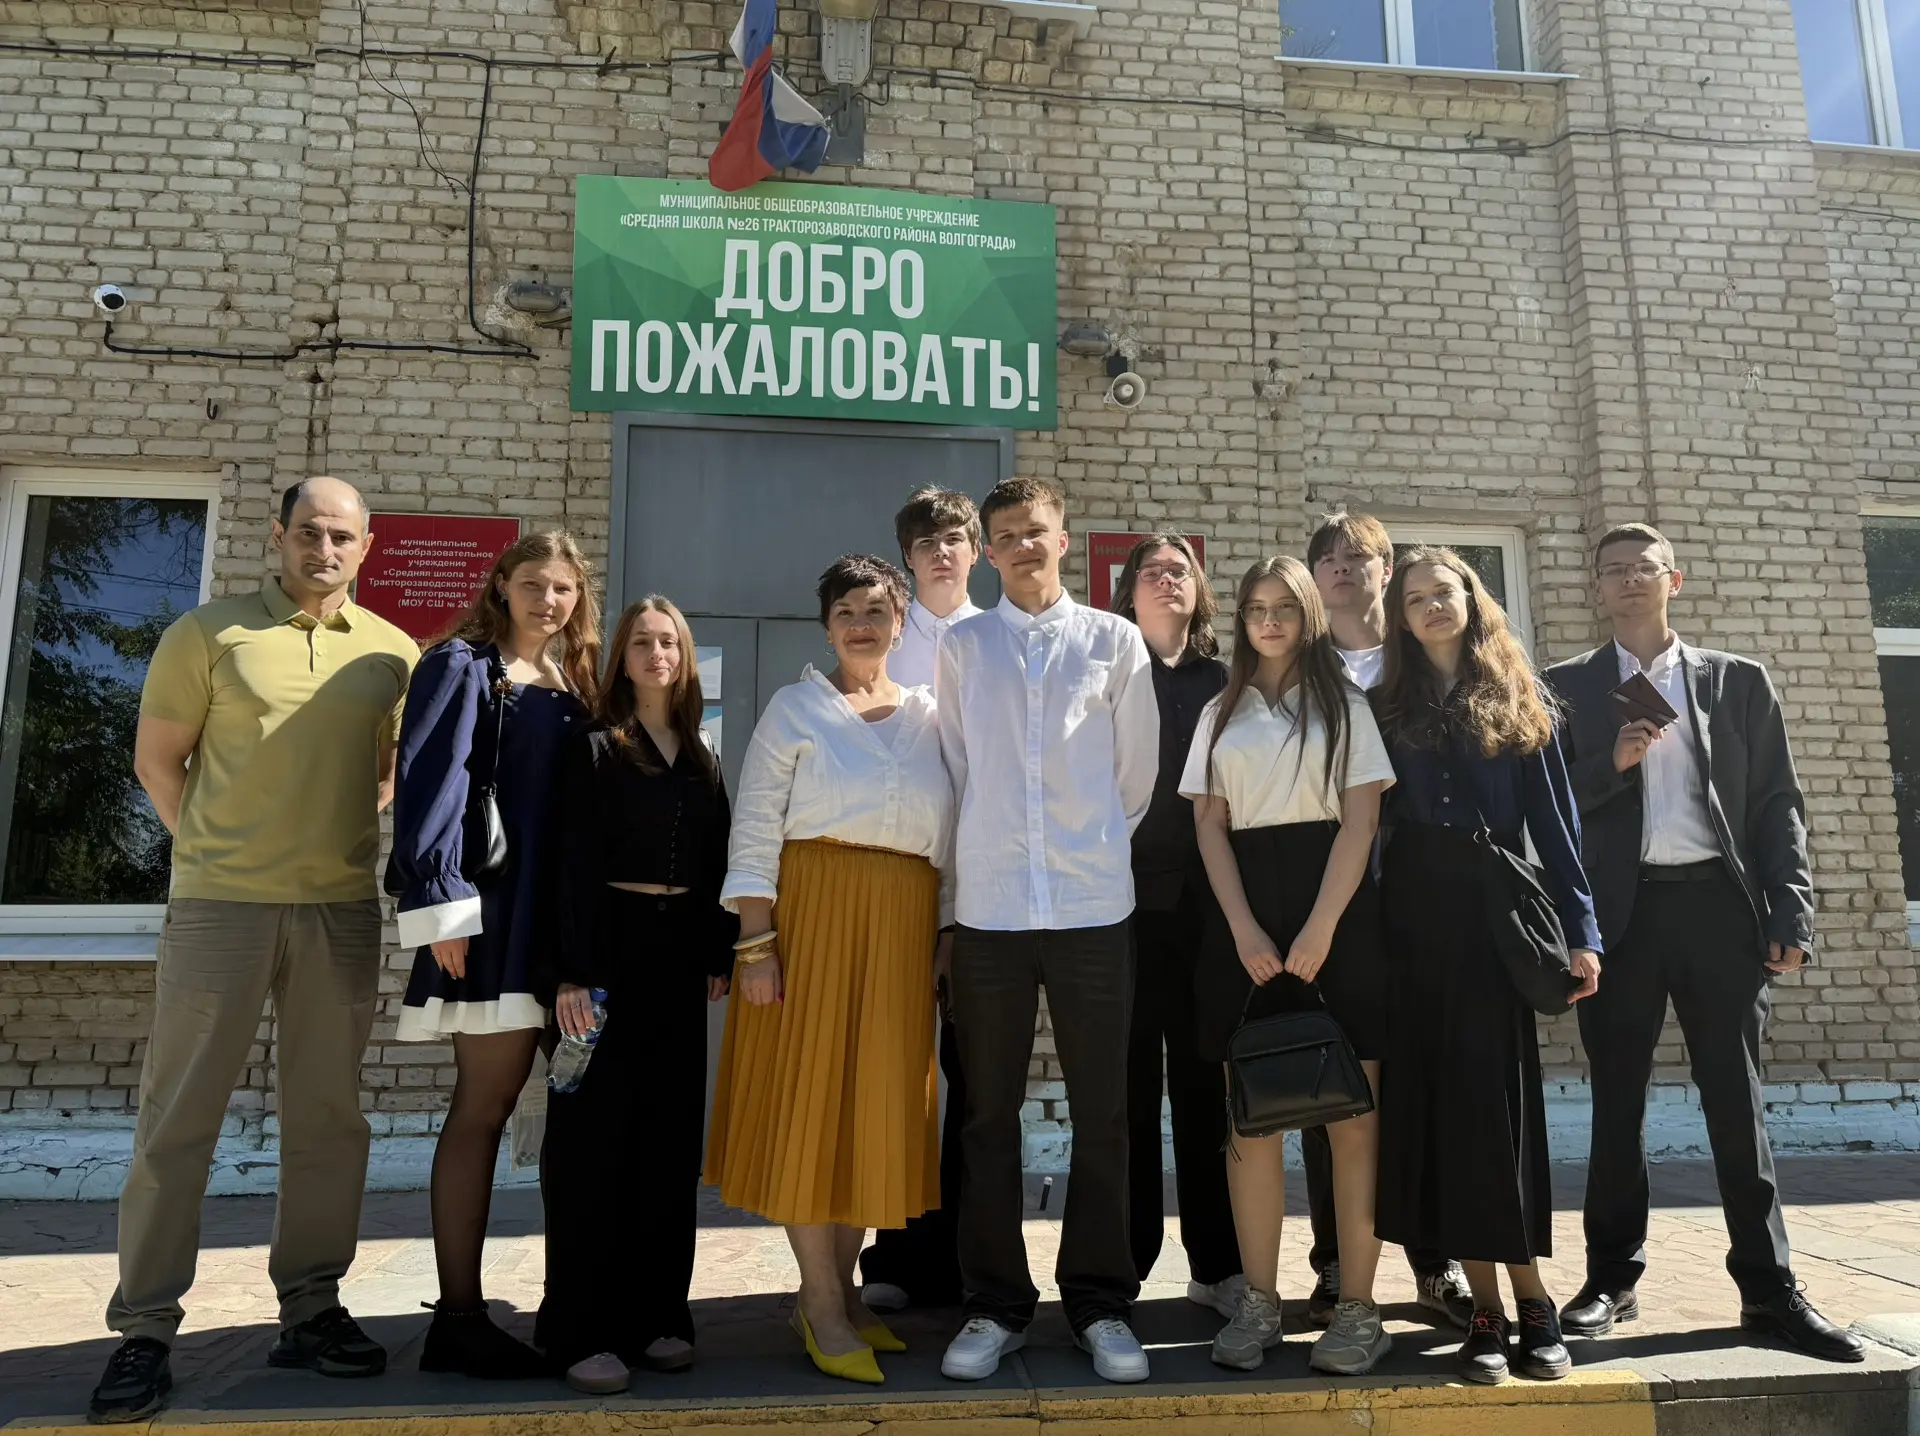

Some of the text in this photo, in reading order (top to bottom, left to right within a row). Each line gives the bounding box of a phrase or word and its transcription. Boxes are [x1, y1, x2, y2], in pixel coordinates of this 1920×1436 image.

[660, 194, 980, 228] МУНИЦИПАЛЬНОЕ ОБЩЕОБРАЗОВАТЕЛЬНОЕ УЧРЕЖДЕНИЕ
[620, 213, 1016, 251] «СРЕДНЯЯ ШКОЛА №26 ТРАКТОРОЗАВОДСКОГО РАЙОНА ВОЛГОГРАДА»
[715, 238, 925, 319] ДОБРО
[590, 319, 1040, 412] ПОЖАЛОВАТЬ!
[400, 539, 478, 548] муниципальное
[382, 548, 494, 558] общеобразовательное
[407, 559, 467, 567] учреждение
[433, 570, 465, 578] школа
[368, 578, 467, 588] Тракторозаводского
[426, 599, 444, 608] СШ
